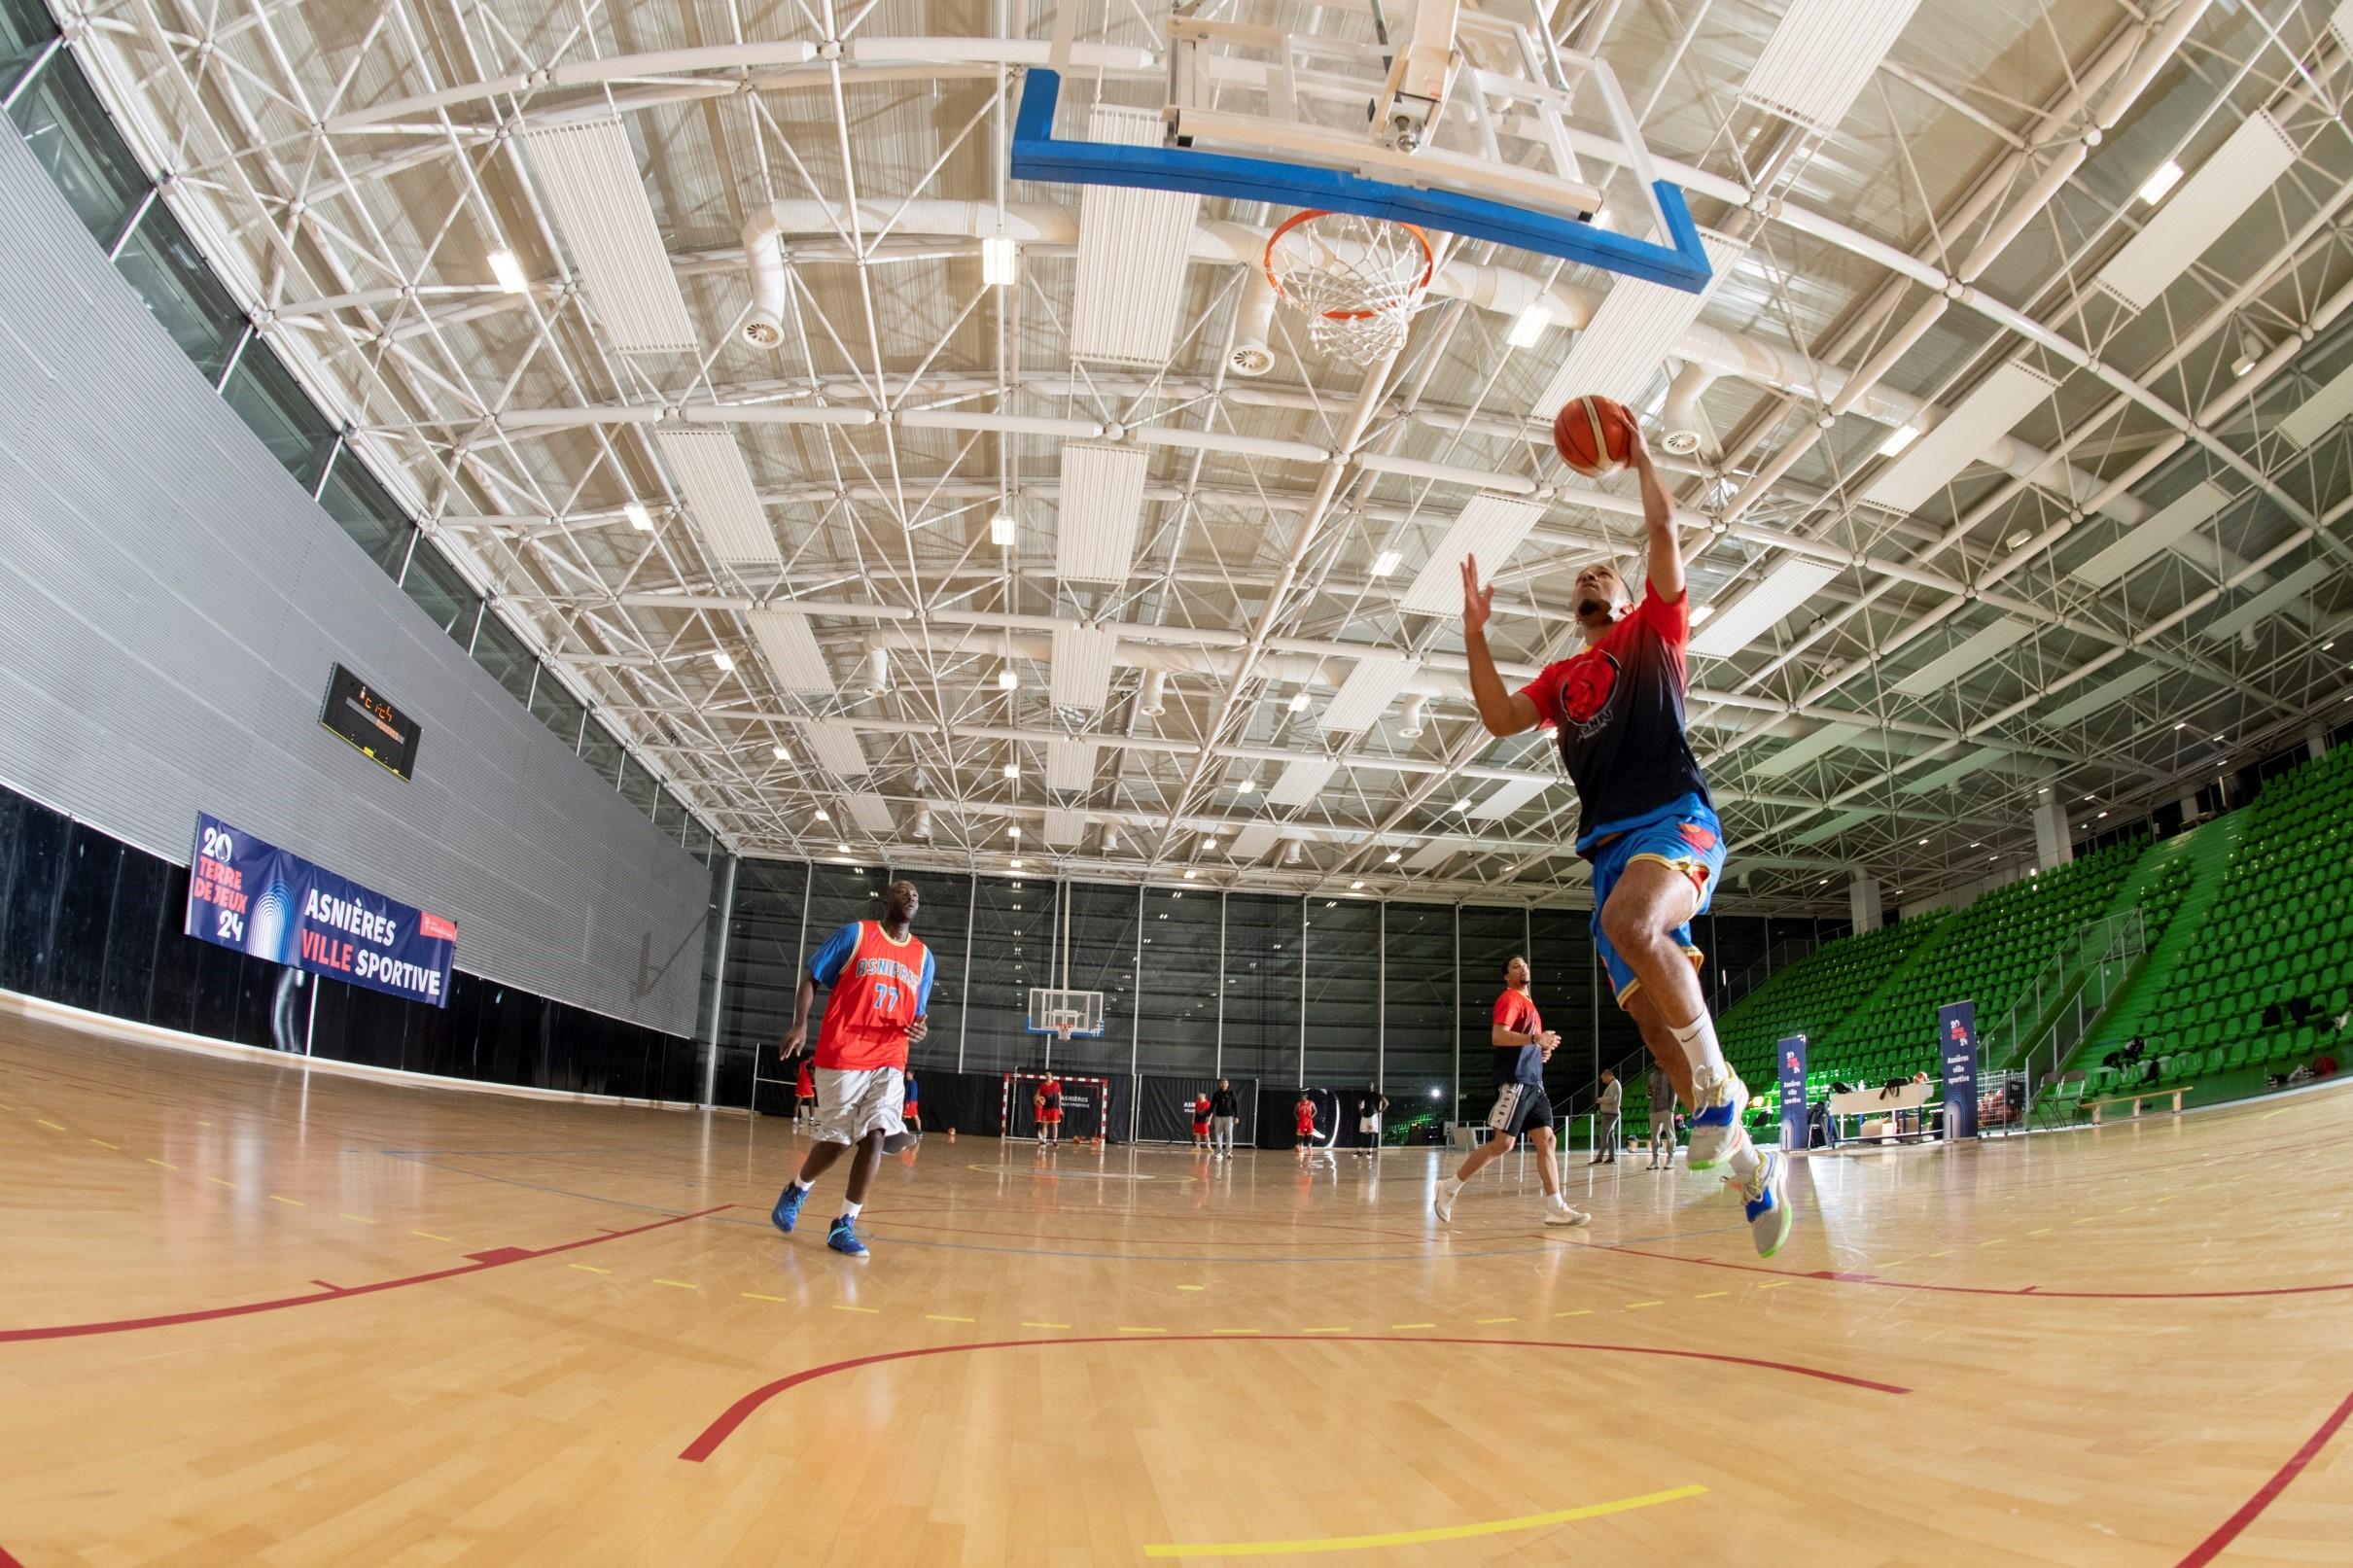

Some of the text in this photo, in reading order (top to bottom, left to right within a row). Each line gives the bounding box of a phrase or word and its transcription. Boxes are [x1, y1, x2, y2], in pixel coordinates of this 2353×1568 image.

[201, 826, 232, 862] 20
[199, 855, 242, 890] TERRE
[193, 877, 248, 914] DE JEUX
[217, 909, 244, 942] 24
[304, 889, 397, 947] ASNIÈRES
[301, 928, 440, 995] VILLE SPORTIVE
[874, 982, 898, 1012] 77
